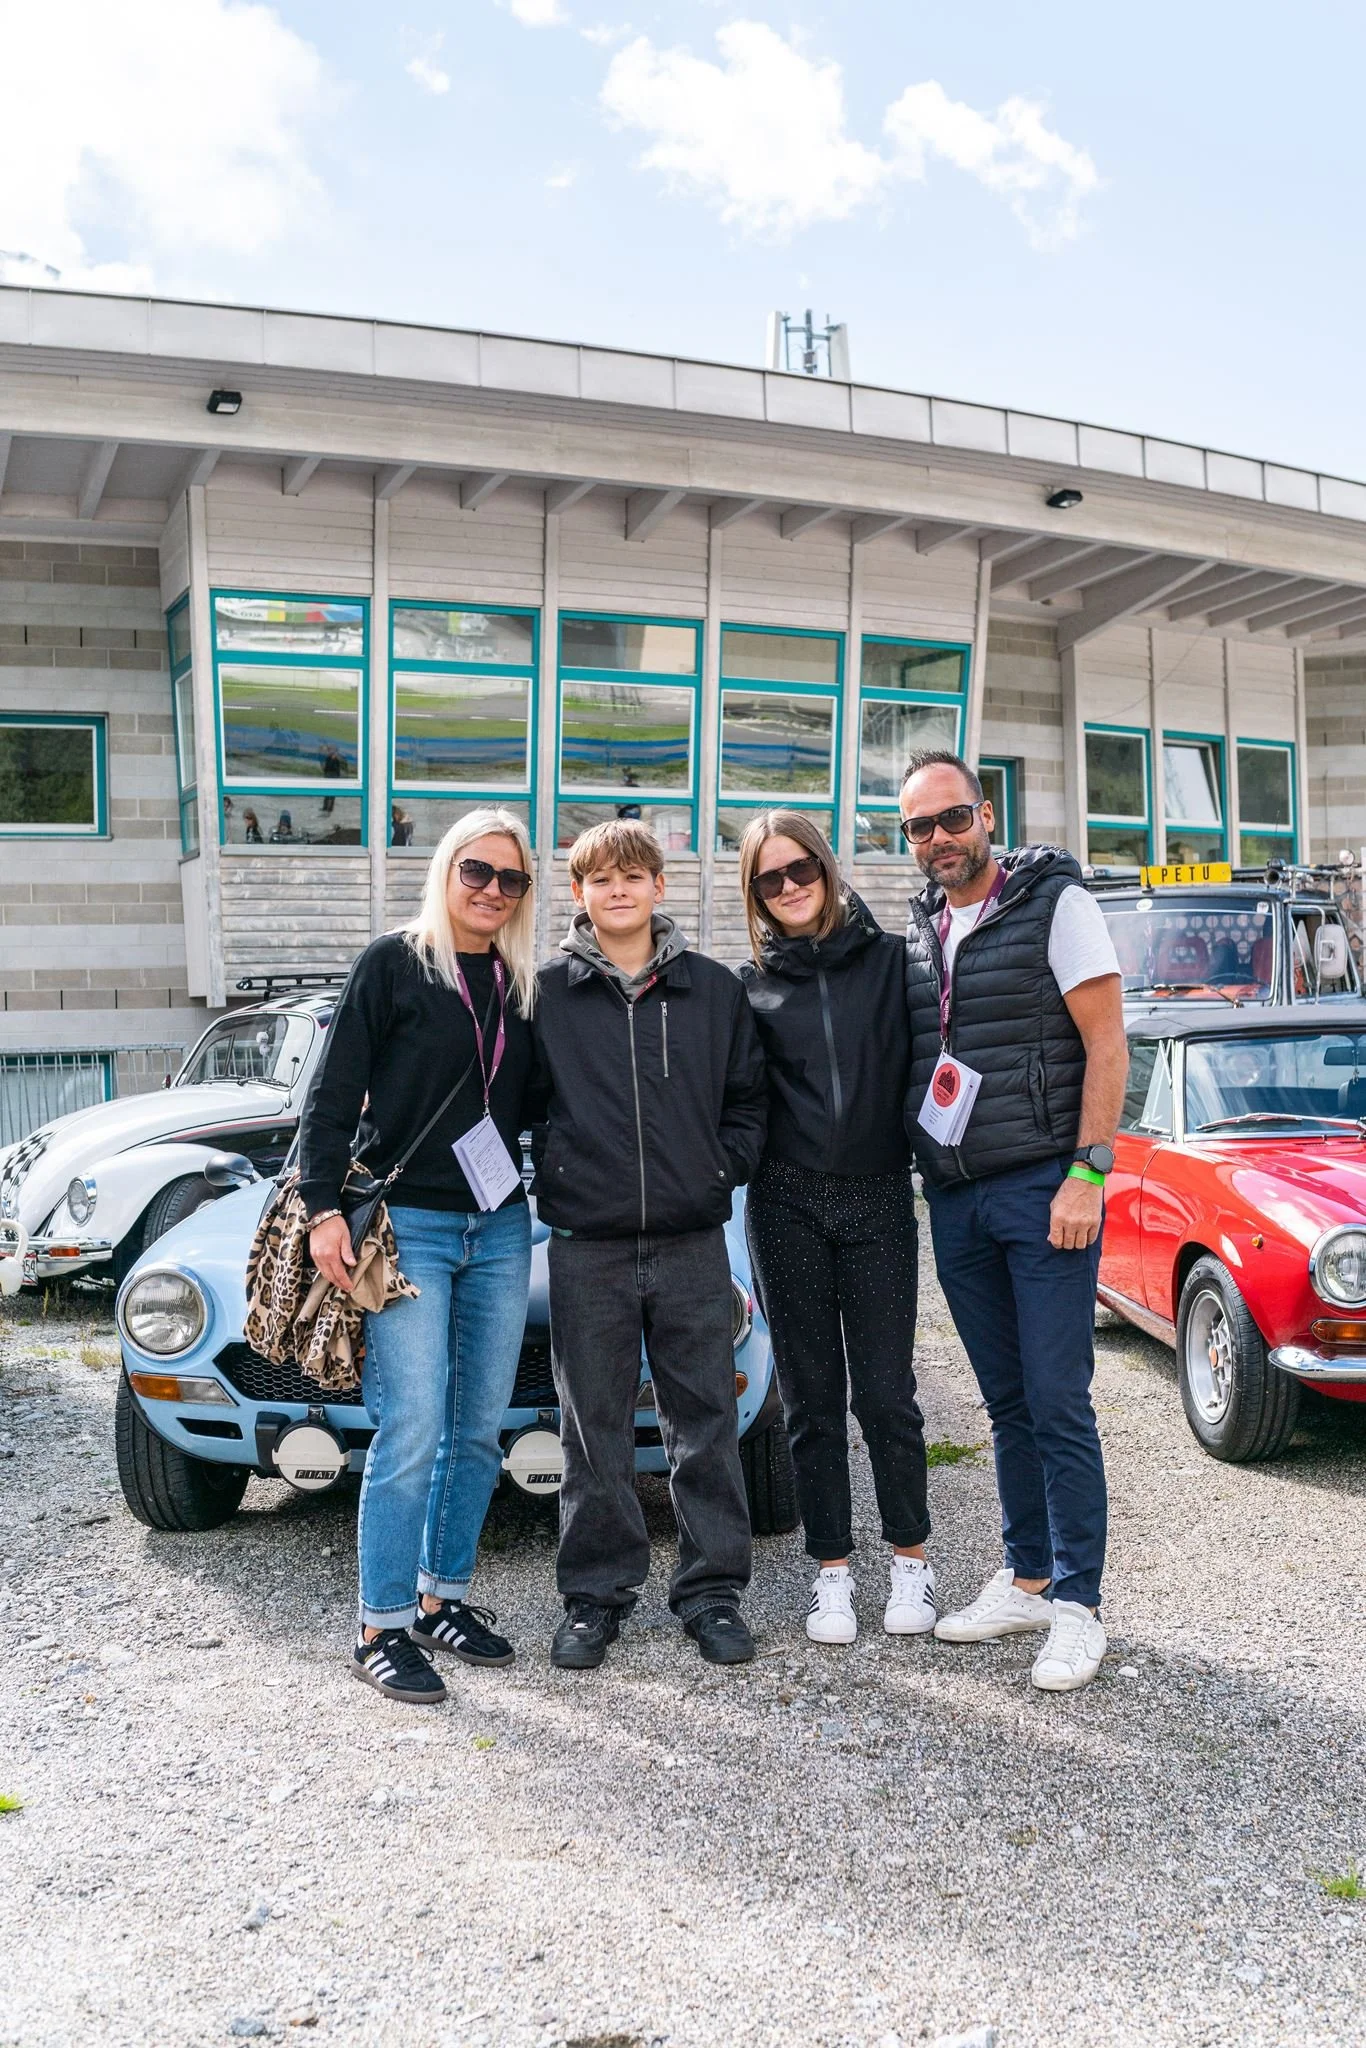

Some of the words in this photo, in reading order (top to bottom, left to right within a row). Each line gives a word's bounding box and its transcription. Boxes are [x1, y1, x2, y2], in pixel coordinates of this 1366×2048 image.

[1161, 865, 1210, 883] PETU
[296, 1470, 335, 1479] FIAT
[528, 1474, 561, 1483] FIA
